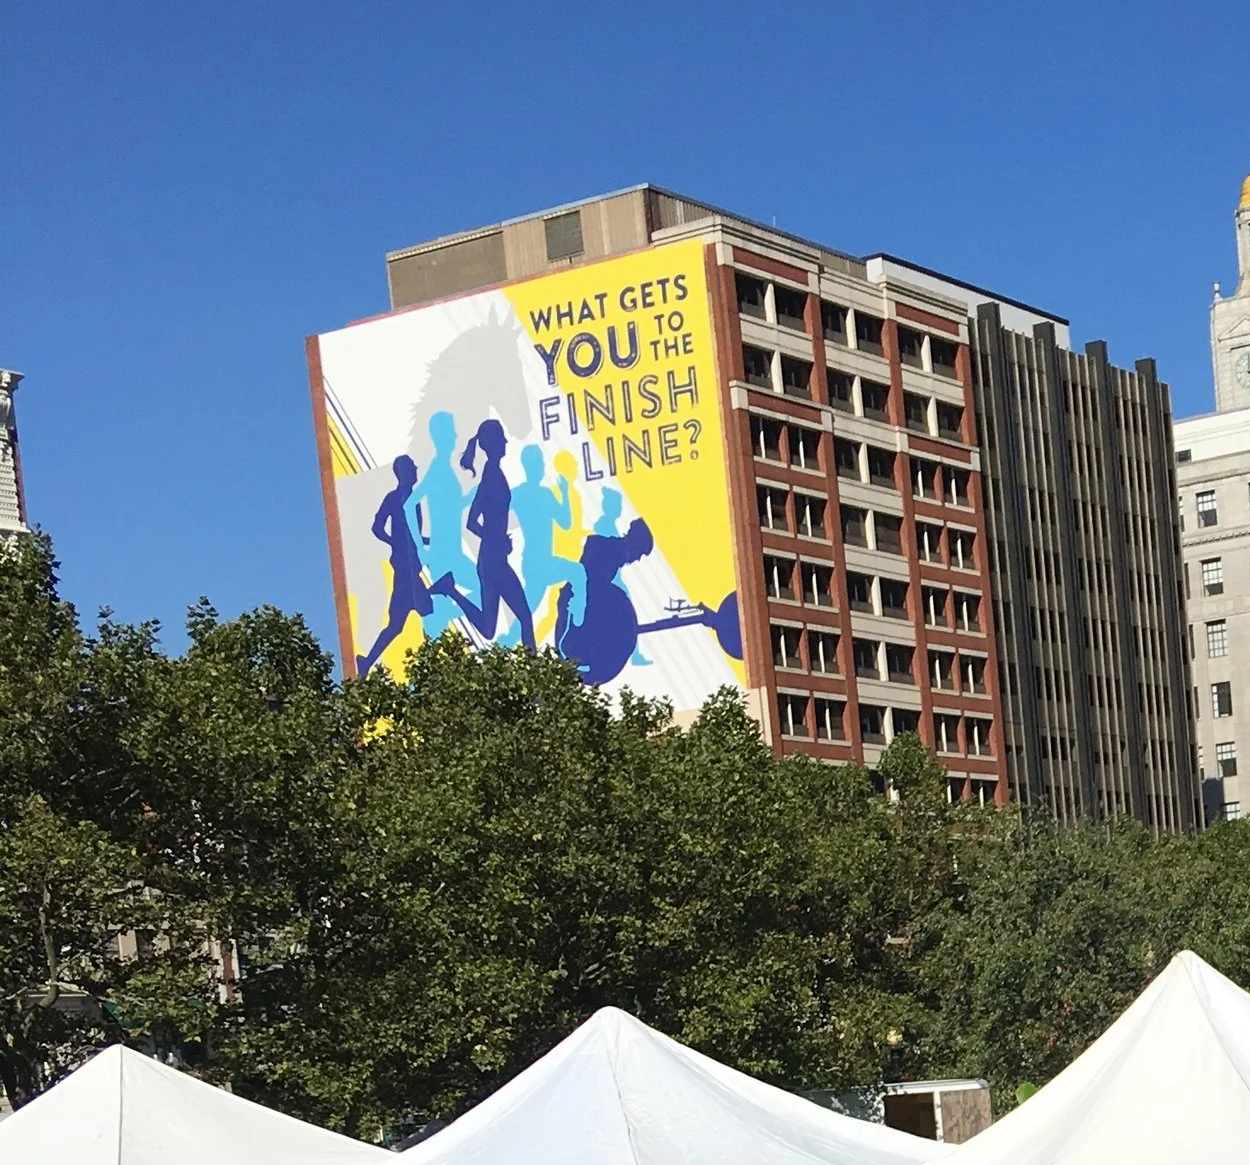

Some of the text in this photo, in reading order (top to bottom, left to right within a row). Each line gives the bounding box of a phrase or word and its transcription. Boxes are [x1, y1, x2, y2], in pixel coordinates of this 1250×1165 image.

[530, 274, 688, 334] WHAT GETS
[653, 310, 684, 335] TO
[534, 321, 641, 388] YOU
[650, 332, 694, 361] THE
[539, 365, 699, 441] FINISH
[582, 418, 702, 482] LINE?
